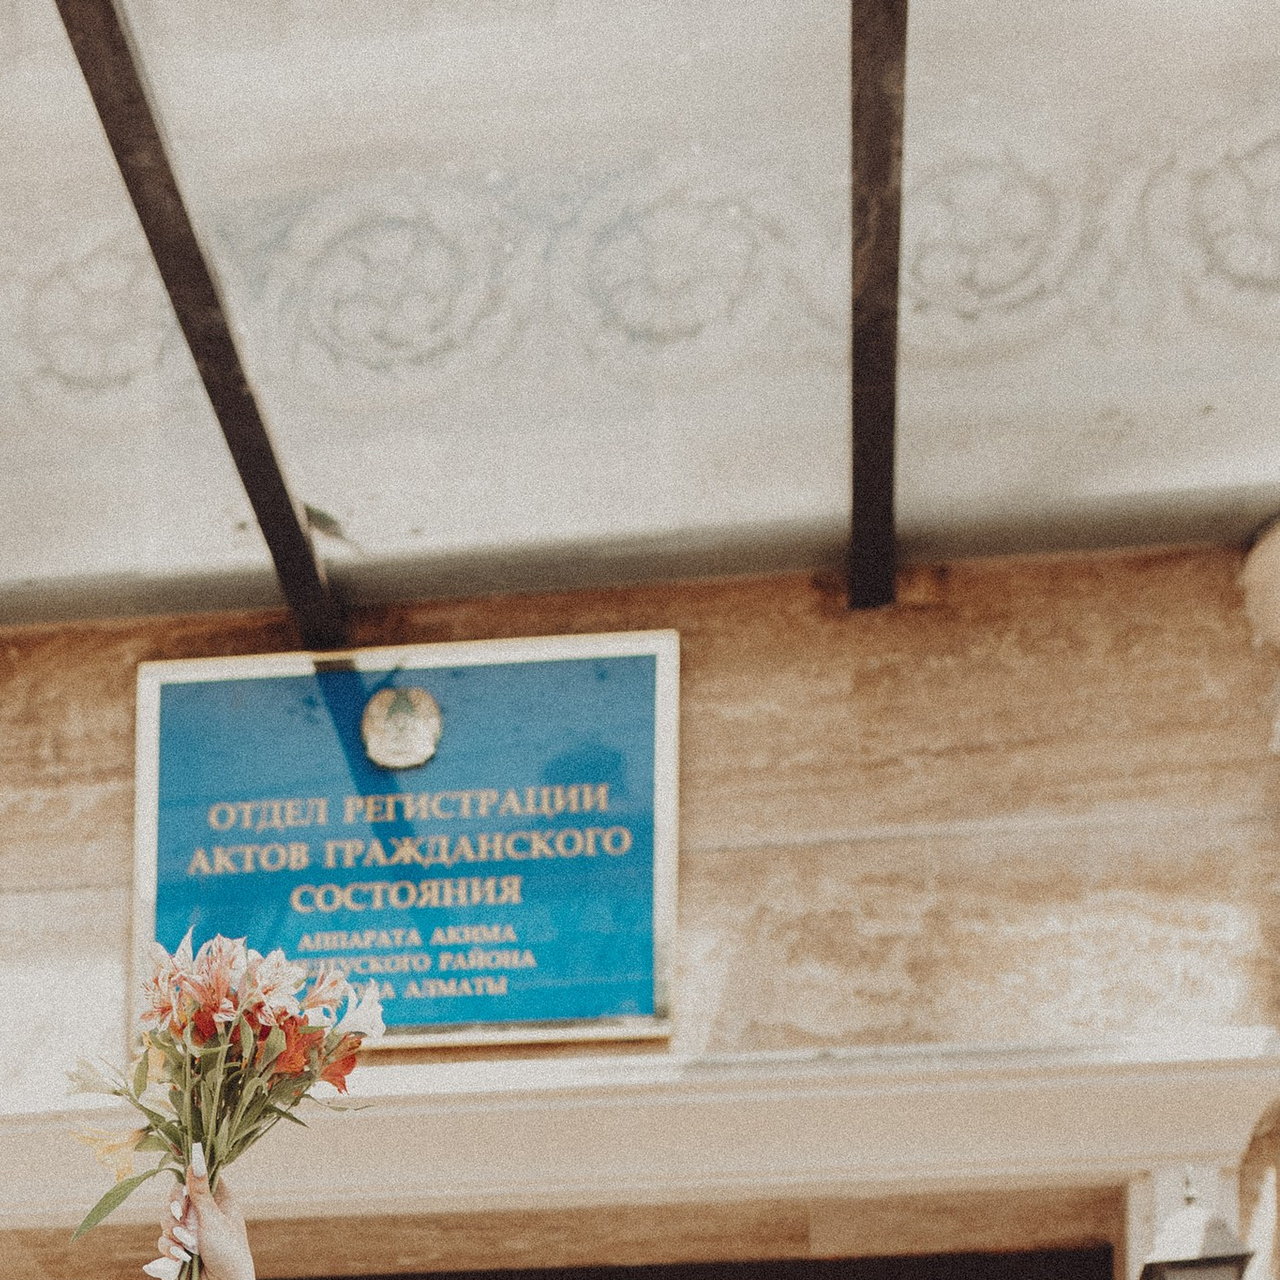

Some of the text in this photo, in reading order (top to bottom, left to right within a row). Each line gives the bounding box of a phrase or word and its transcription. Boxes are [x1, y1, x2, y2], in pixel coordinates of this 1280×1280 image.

[207, 783, 610, 833] ОТДЕЛ РЕГИСТРАЦИИ
[187, 825, 633, 876] АКТОВ ГРАЖДАНСКОГО
[289, 874, 522, 914] СОСТОЯНИЯ
[297, 923, 519, 951] АППАРАТА АКИМА
[438, 948, 539, 972] РАЙОНА
[402, 975, 509, 1000] АЛМАТЫ
